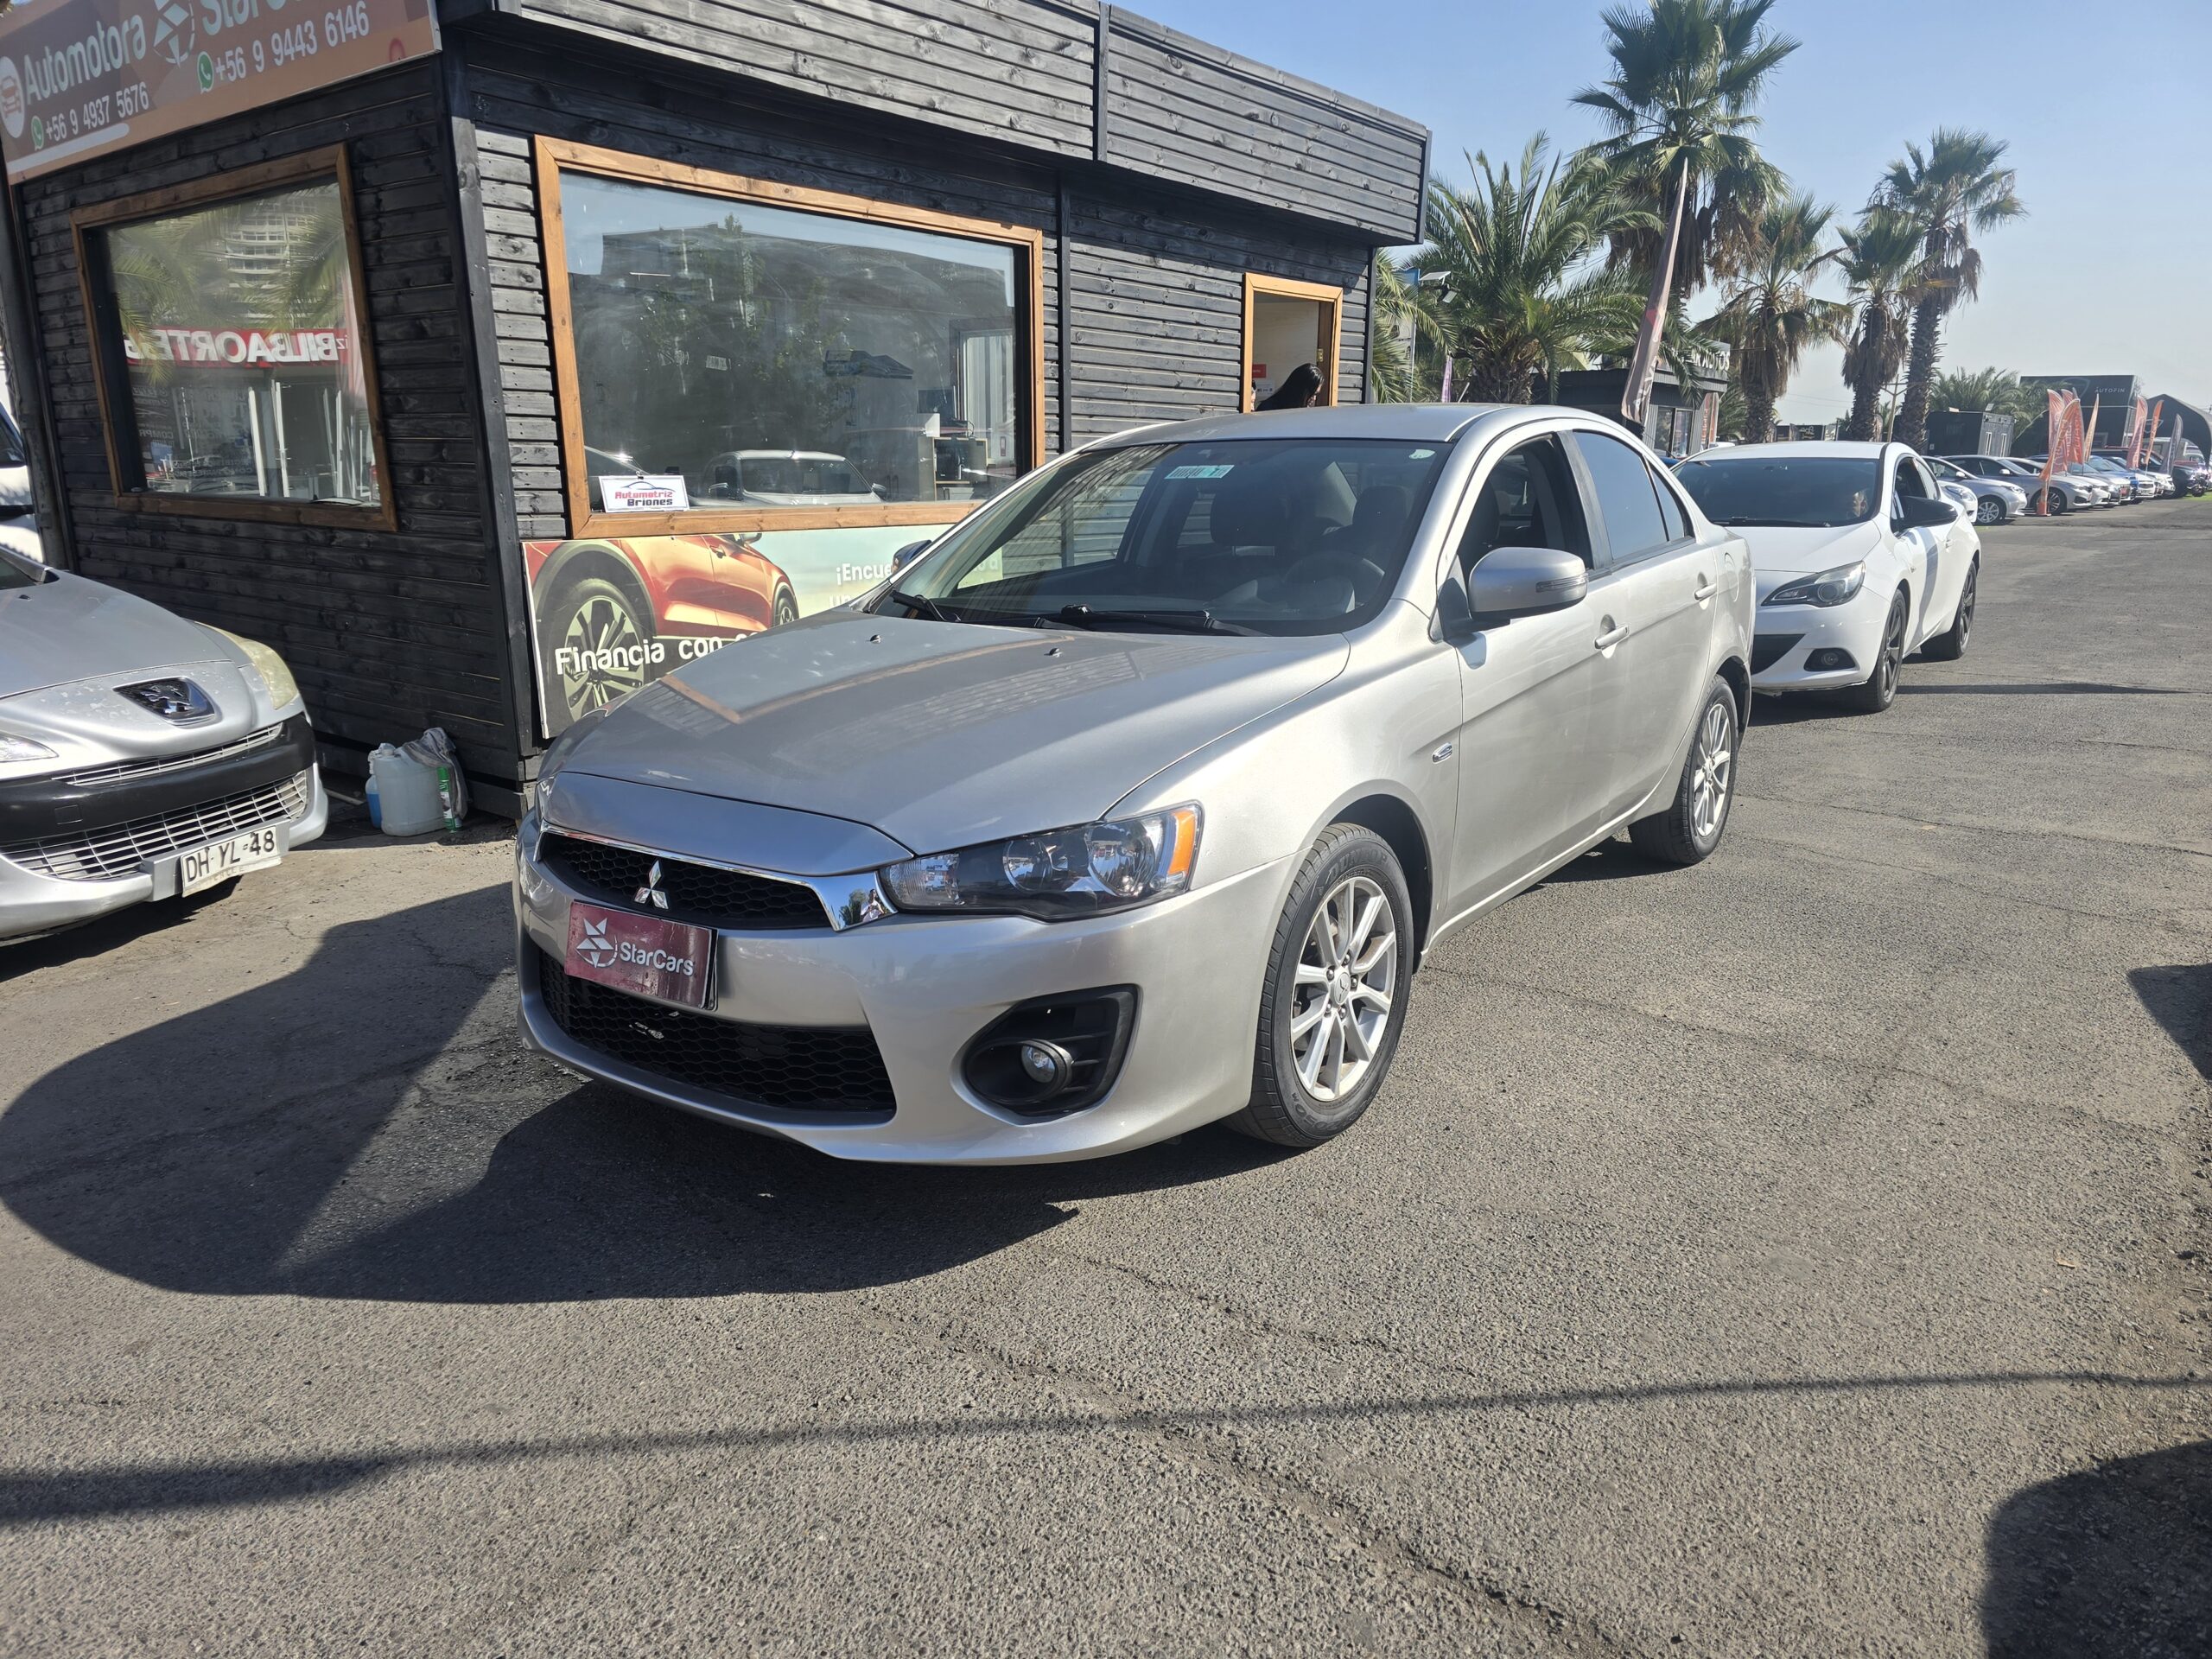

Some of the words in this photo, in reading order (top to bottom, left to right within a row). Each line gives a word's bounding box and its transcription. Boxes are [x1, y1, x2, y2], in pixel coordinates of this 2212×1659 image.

[23, 14, 147, 105] Automotora
[216, 46, 247, 82] +56
[252, 40, 265, 73] 9
[270, 20, 317, 67] 9443
[324, 0, 370, 48] 6146
[46, 112, 67, 142] +56
[69, 109, 79, 135] 9
[83, 95, 110, 130] 4937
[116, 81, 149, 118] 5676
[614, 491, 673, 499] Automotriz
[836, 563, 892, 585] ¡Encue
[555, 639, 665, 675] Financia
[678, 636, 722, 659] con
[219, 841, 241, 868] YL
[620, 941, 694, 976] StarCars
